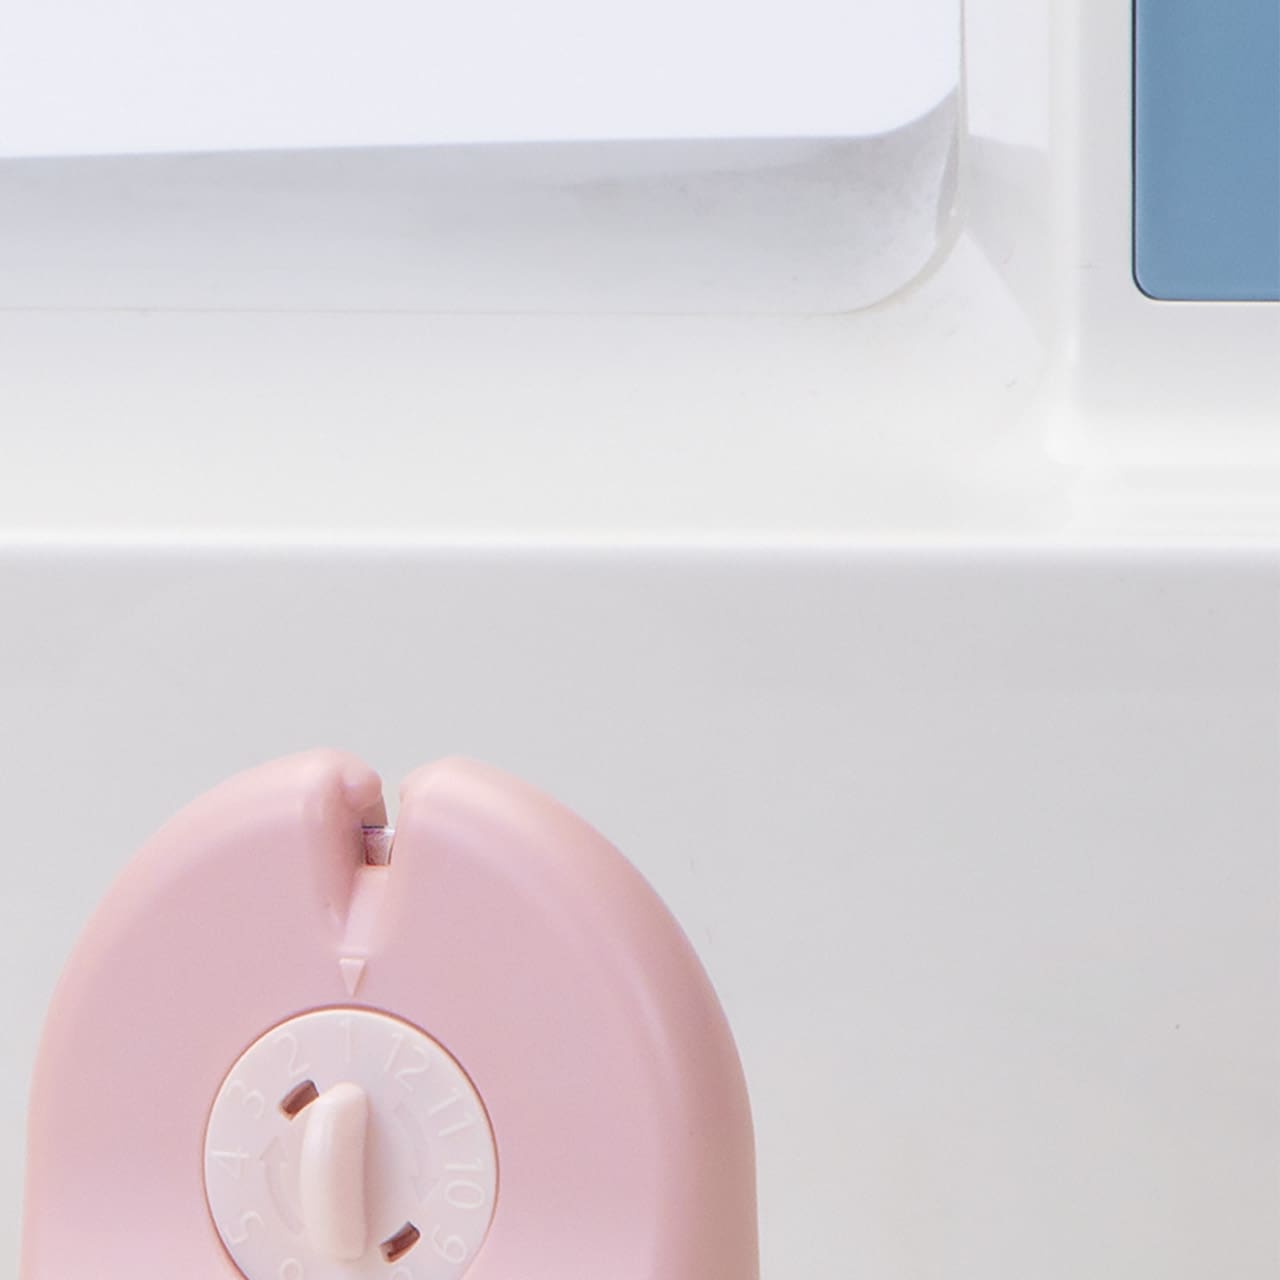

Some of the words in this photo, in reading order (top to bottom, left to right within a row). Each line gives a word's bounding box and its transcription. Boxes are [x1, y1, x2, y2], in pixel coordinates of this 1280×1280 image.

[273, 1031, 311, 1076] 2
[383, 1032, 430, 1091] 12
[227, 1080, 266, 1121] 3
[427, 1088, 476, 1137] 11
[444, 1158, 485, 1210] 10
